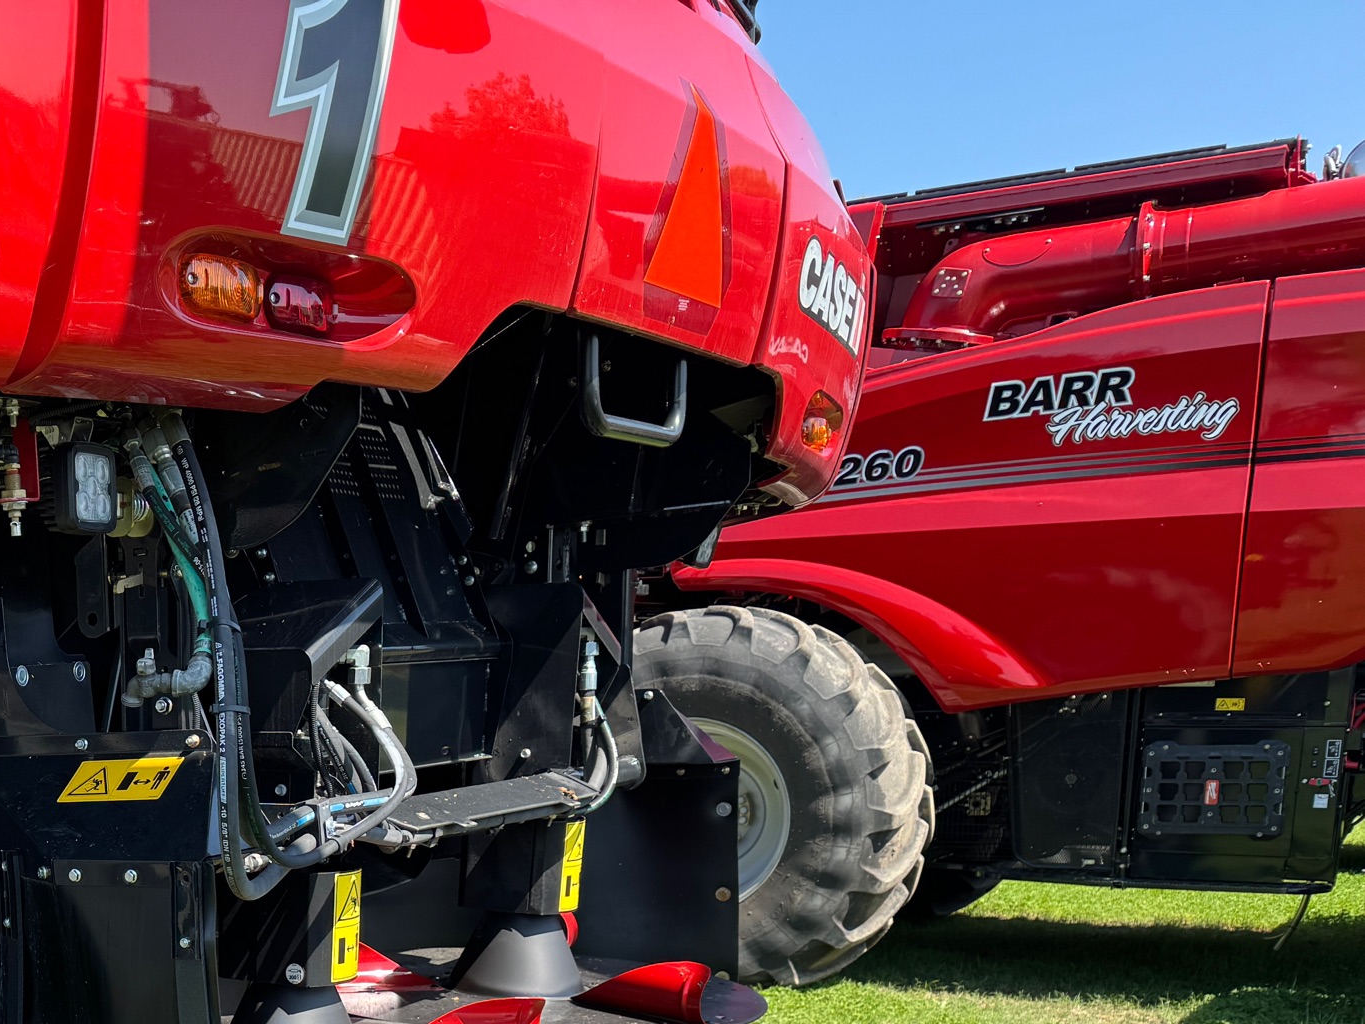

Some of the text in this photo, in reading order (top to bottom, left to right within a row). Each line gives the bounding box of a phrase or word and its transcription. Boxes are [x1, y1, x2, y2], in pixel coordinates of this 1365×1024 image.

[269, 0, 400, 247] 1
[799, 238, 856, 342] CASE
[982, 366, 1136, 422] BARR
[1046, 391, 1240, 447] Harvesting
